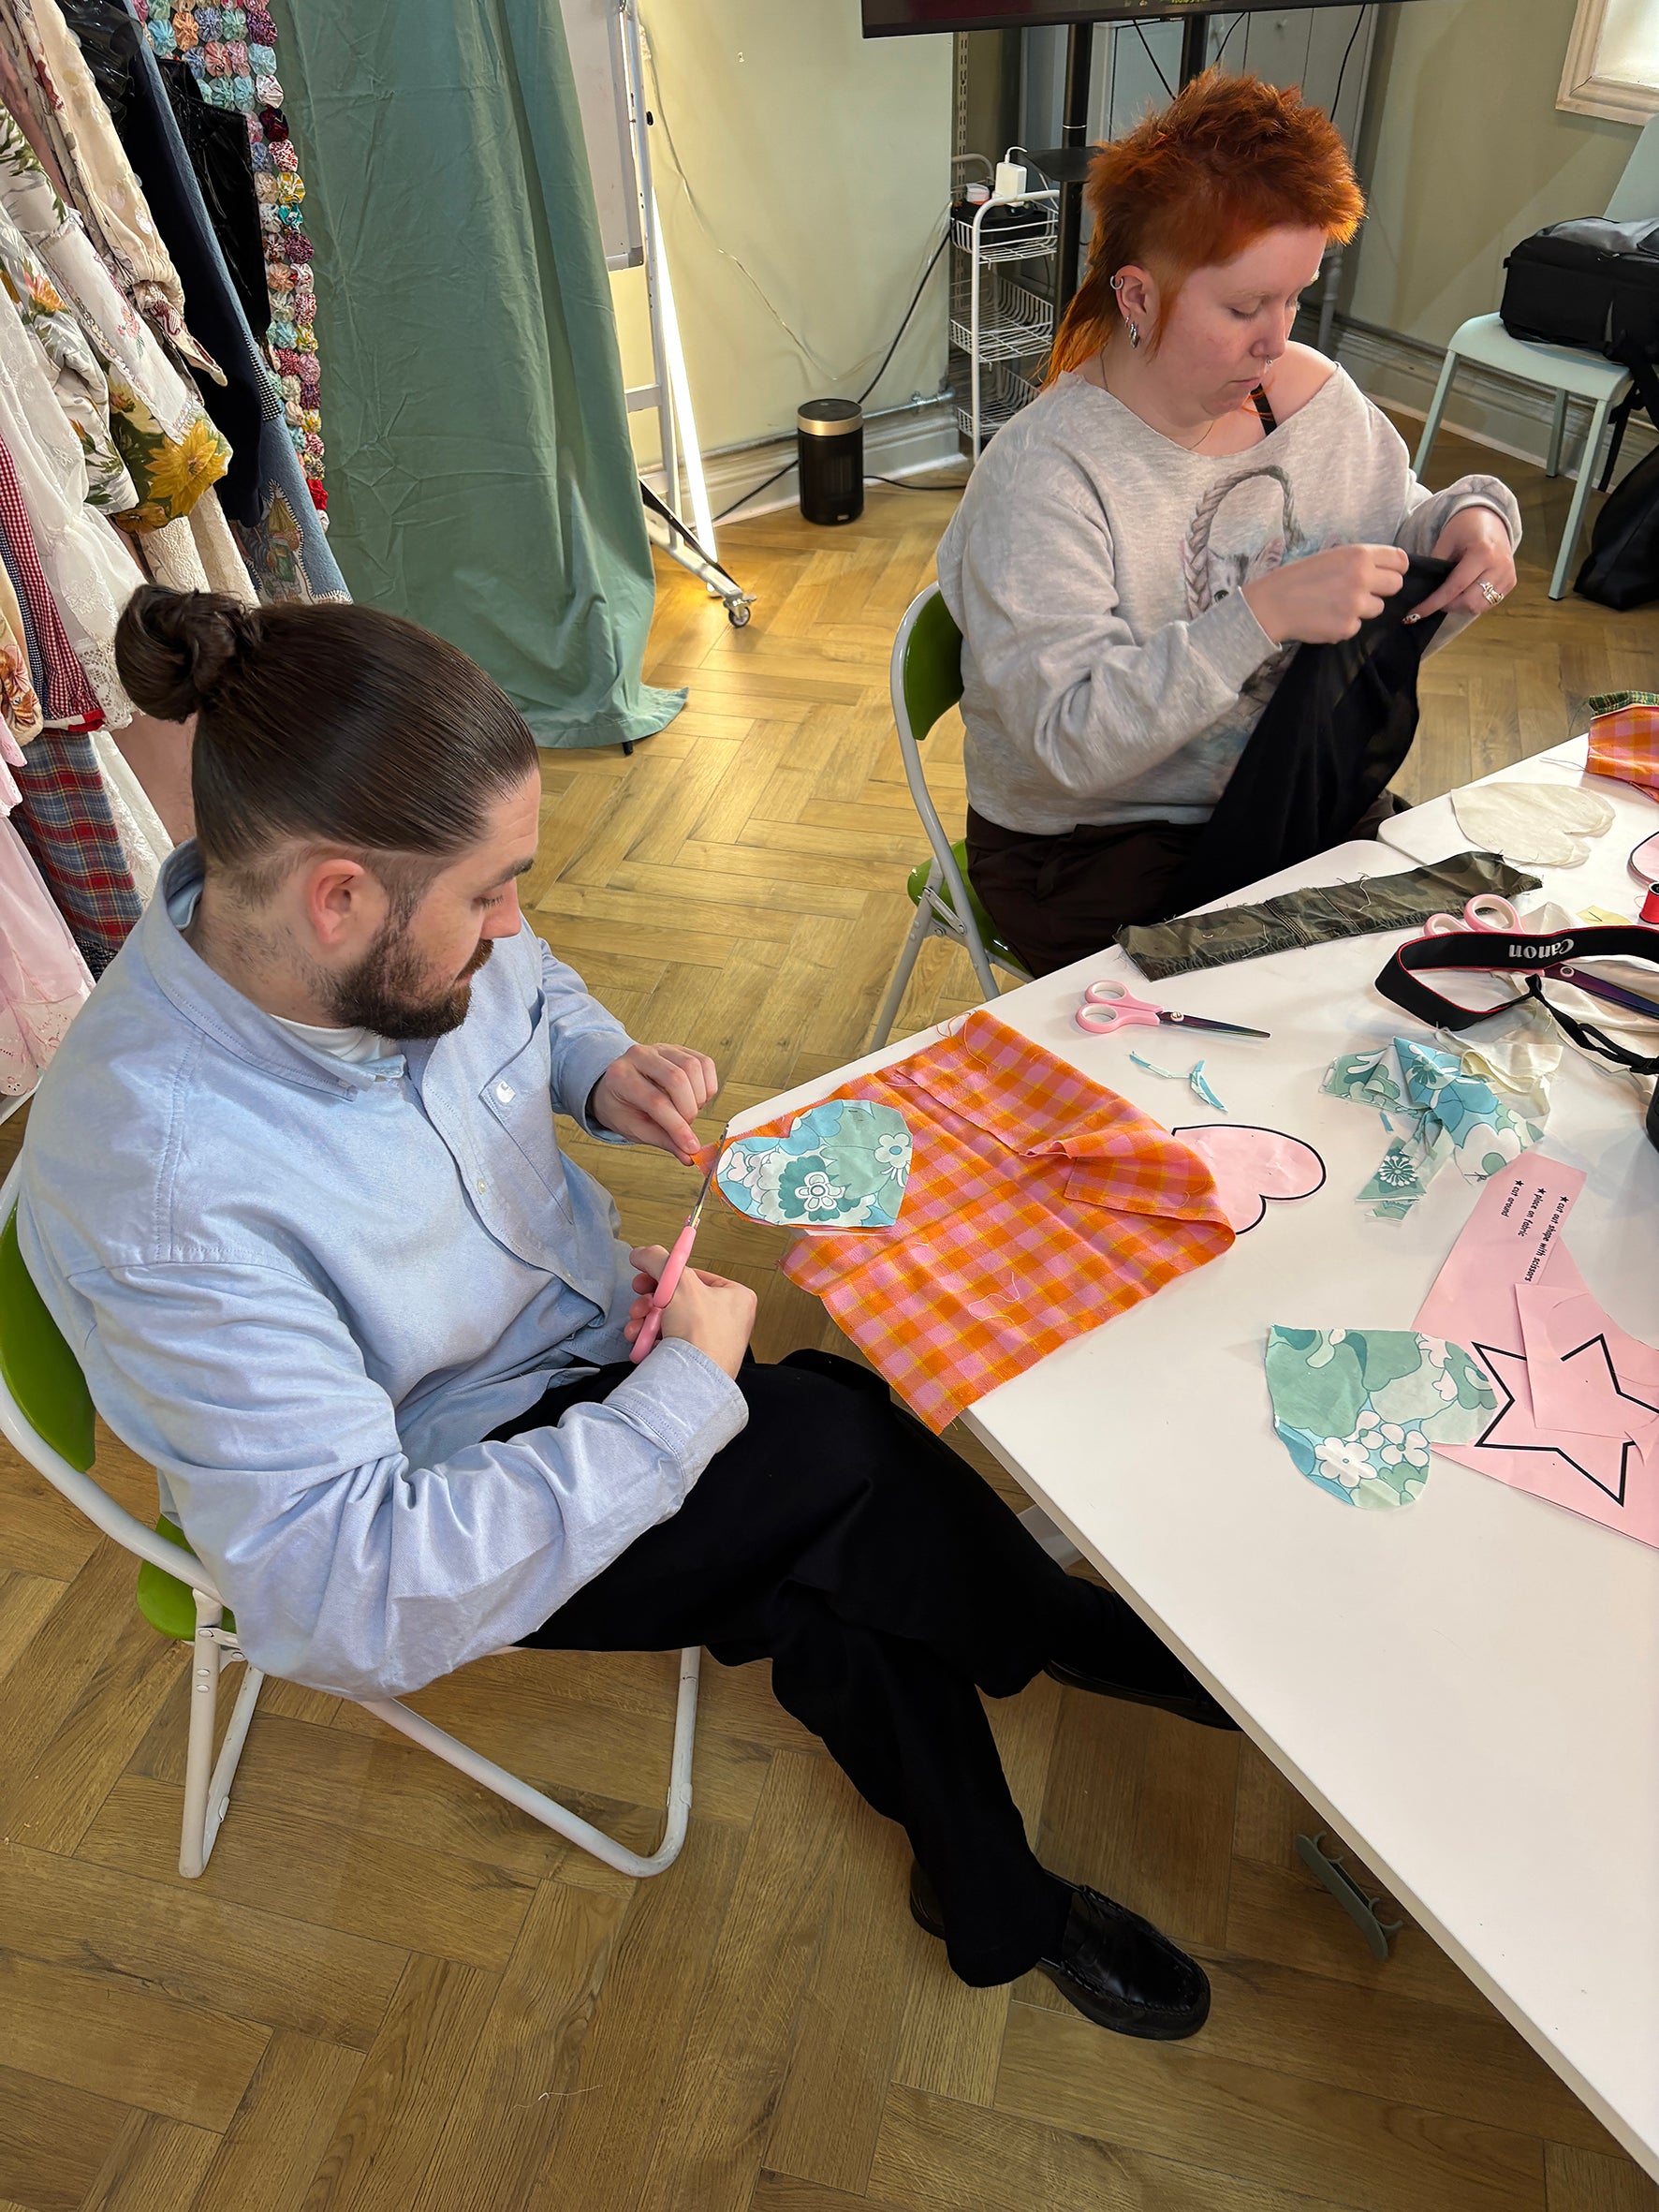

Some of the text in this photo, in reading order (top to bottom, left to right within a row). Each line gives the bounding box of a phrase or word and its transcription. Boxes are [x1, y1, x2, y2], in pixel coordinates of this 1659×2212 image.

[1508, 938, 1575, 959] Canon
[1501, 1186, 1520, 1217] cut around
[1518, 1193, 1544, 1237] place on fabric
[1524, 1202, 1565, 1282] cut out shape with scissors
